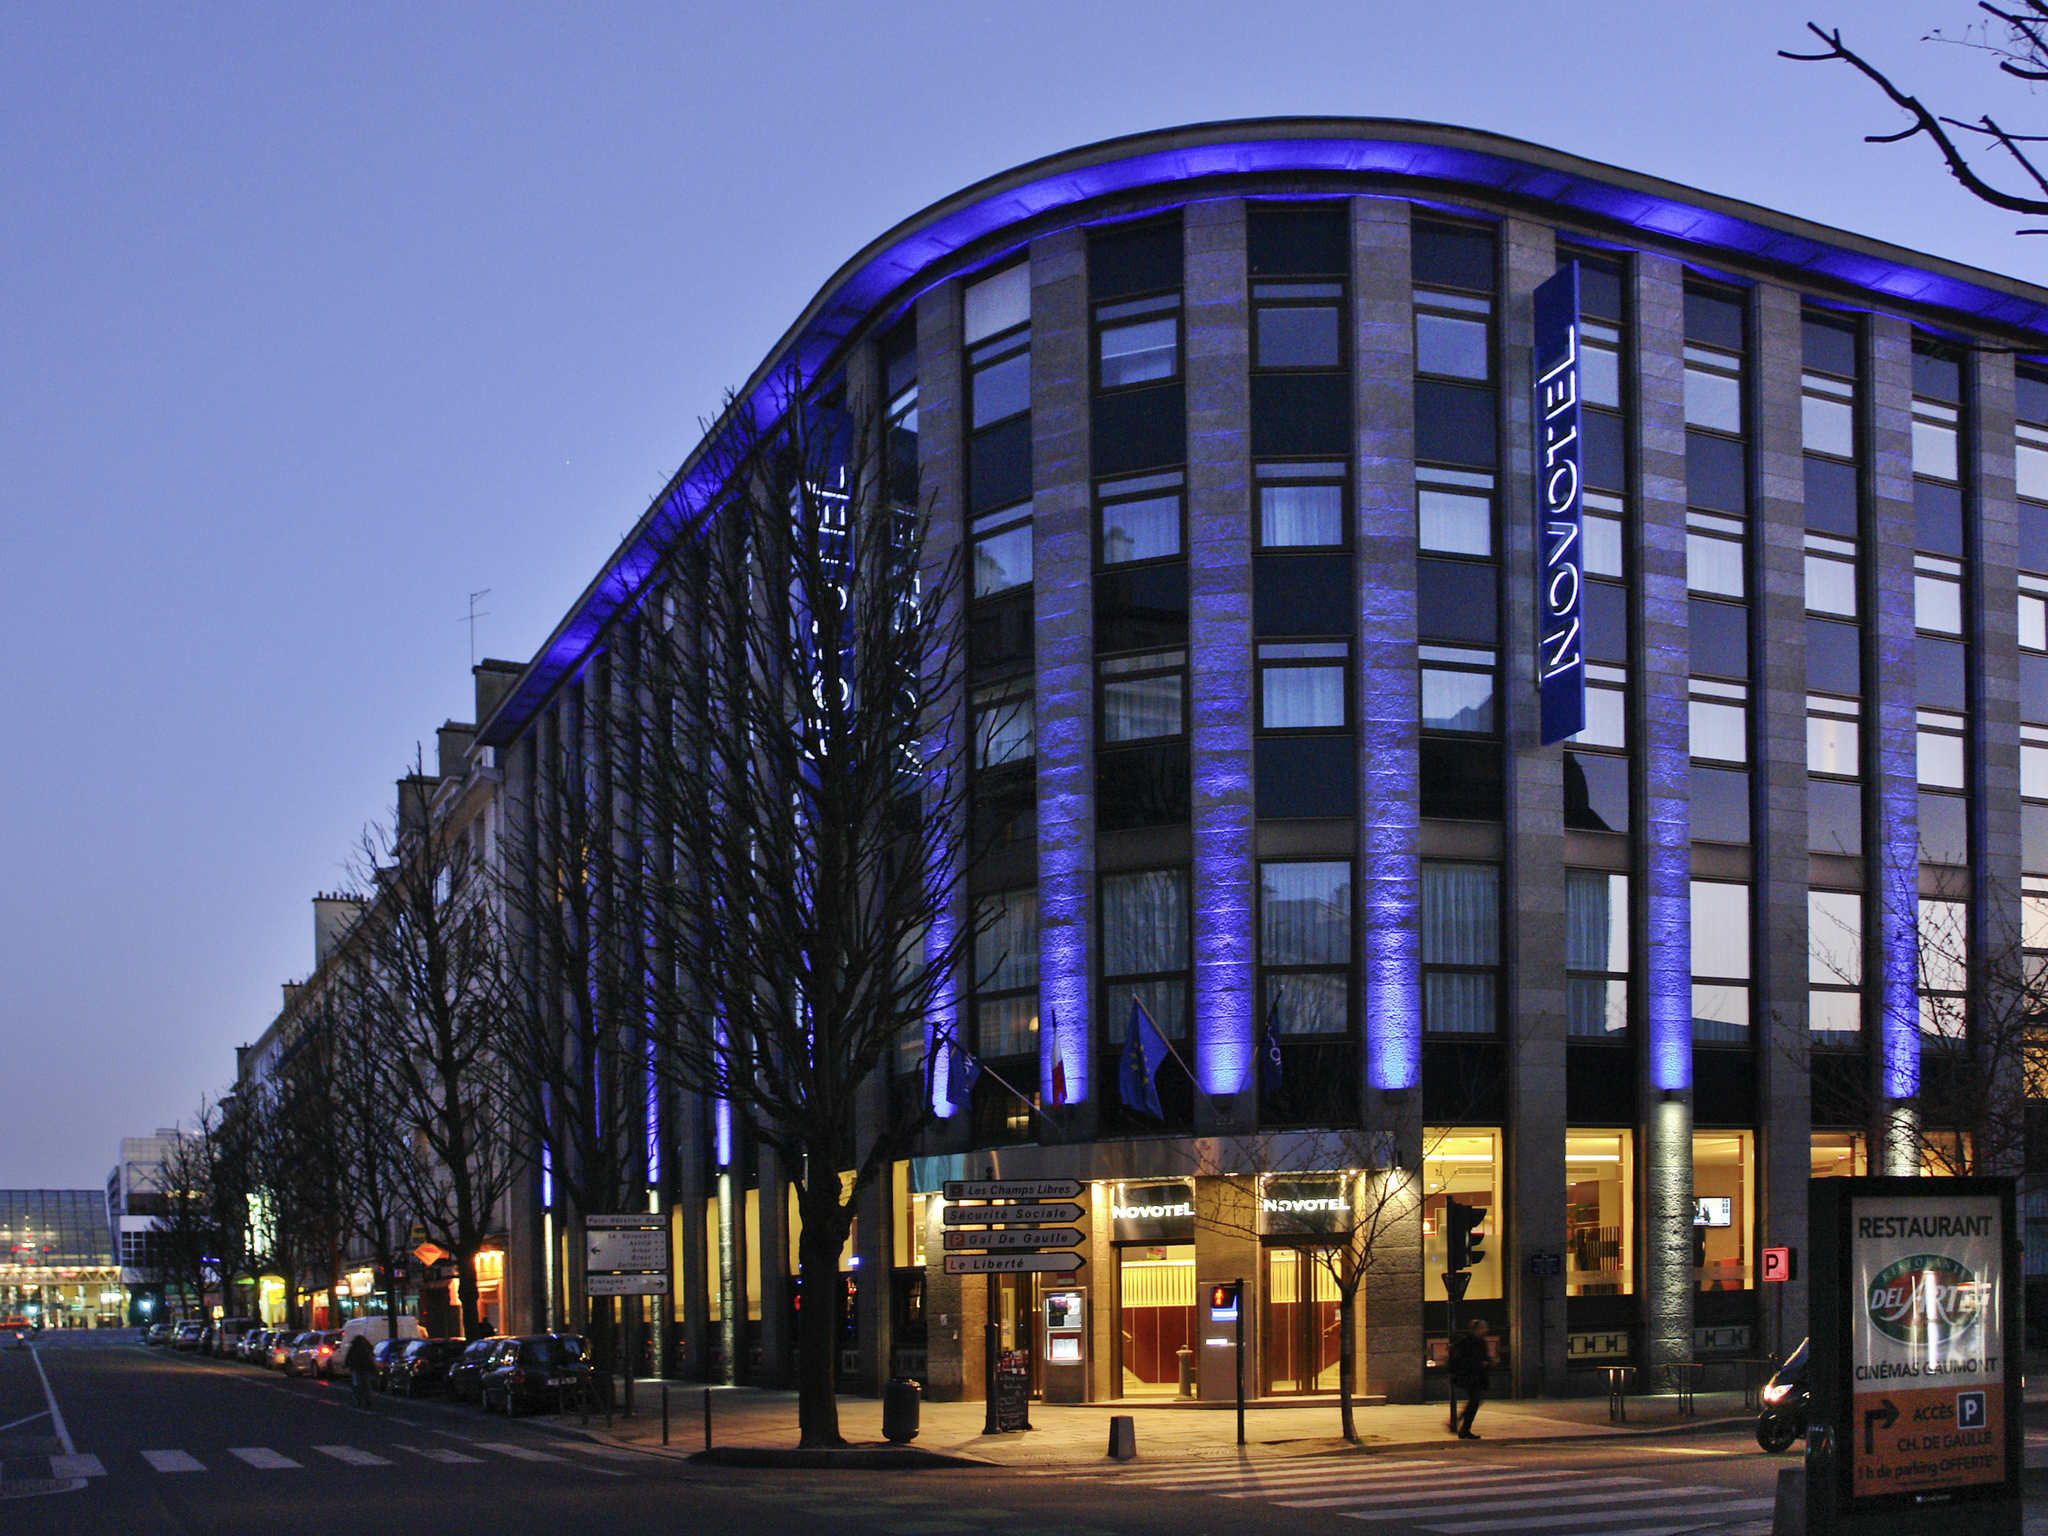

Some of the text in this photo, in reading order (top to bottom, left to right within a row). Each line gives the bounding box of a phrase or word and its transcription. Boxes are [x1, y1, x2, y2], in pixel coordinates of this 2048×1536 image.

[1538, 324, 1580, 679] NOVOTEL
[968, 1183, 1072, 1197] Les Champs Libres
[1112, 1202, 1195, 1219] NOVOTEL
[1263, 1196, 1351, 1212] NOVOTEL
[950, 1207, 1067, 1221] Sécurité Sociale
[1858, 1215, 1993, 1238] RESTAURANT
[969, 1234, 993, 1245] Gal
[998, 1233, 1016, 1244] De
[1023, 1232, 1068, 1244] Gaulle
[950, 1257, 1025, 1270] Le Liberté
[1766, 1254, 1778, 1276] P
[1855, 1360, 1920, 1381] CINÉMAS
[1912, 1399, 1978, 1422] ACCÈS P
[1922, 1435, 1941, 1450] DE
[1943, 1431, 1992, 1448] GAULLE
[1877, 1464, 1892, 1478] de
[1895, 1459, 1938, 1480] parking
